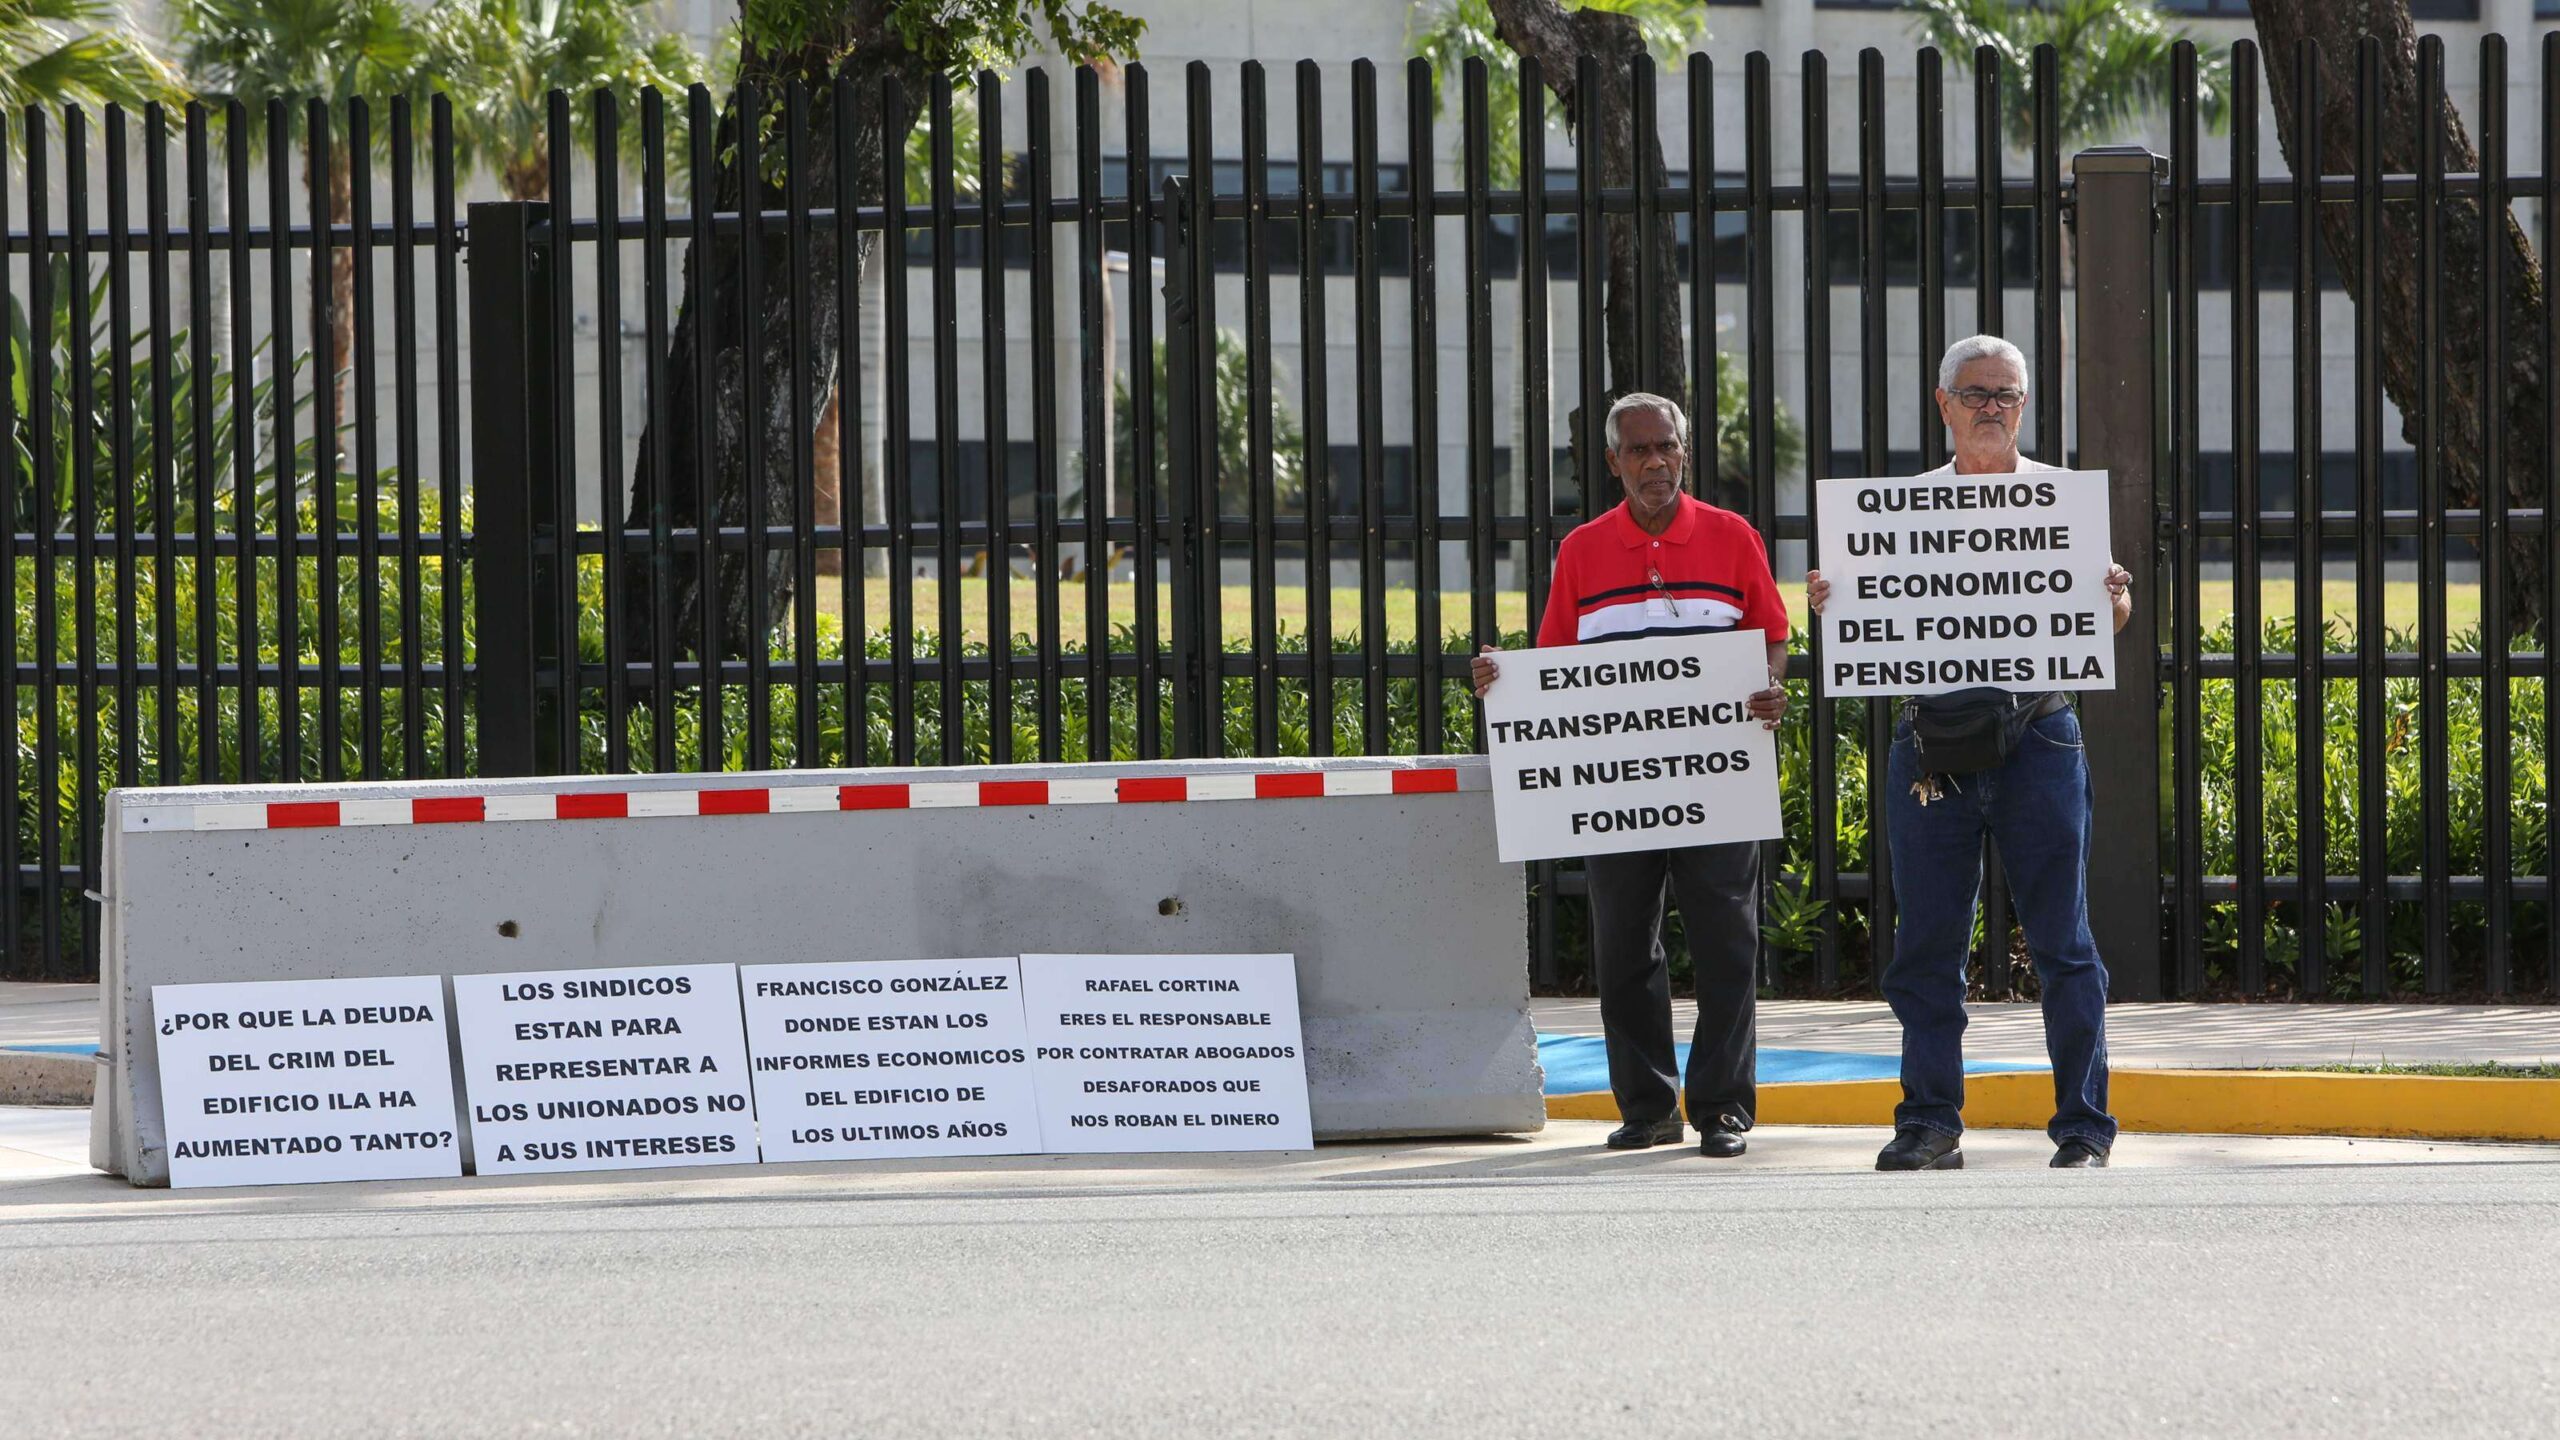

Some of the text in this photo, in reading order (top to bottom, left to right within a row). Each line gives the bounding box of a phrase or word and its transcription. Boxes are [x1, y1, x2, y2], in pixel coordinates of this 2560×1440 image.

[1857, 482, 2056, 515] QUEREMOS
[1847, 525, 2070, 557] UN INFORME
[1857, 569, 2073, 600] ECONOMICO
[1838, 612, 2096, 644] DEL FONDO DE
[1539, 656, 1701, 691] EXIGIMOS
[1834, 655, 2105, 687] PENSIONES ILA
[1490, 701, 1756, 745] TRANSPARENCI
[1518, 749, 1750, 791] EN NUESTROS
[1571, 802, 1706, 835] FONDOS
[502, 976, 692, 1002] LOS SINDICOS
[756, 970, 1009, 997] FRANCISCO GONZÁLEZ
[1085, 979, 1240, 993] RAFAEL CORTINA
[160, 1005, 434, 1036] ¿POR QUE LA DEUDA
[514, 1016, 682, 1041] ESTAN PARA
[784, 1013, 989, 1034] DONDE ESTAN LOS
[1059, 1013, 1272, 1026] ERES EL RESPONSABLE
[208, 1049, 395, 1072] DEL CRIM DEL
[756, 1048, 1026, 1072] INFORMES ECONOMICOS
[1036, 1046, 1295, 1060] POR CONTRATAR ABOGADOS
[495, 1055, 718, 1082] REPRESENTAR A
[805, 1086, 986, 1107] DEL EDIFICIO DE
[1083, 1079, 1261, 1093] DESAFORADOS QUE
[203, 1090, 417, 1115] EDIFICIO ILA HA
[476, 1094, 746, 1123] LOS UNIONADOS NO
[791, 1120, 1008, 1144] LOS ULTIMOS AÑOS
[1070, 1113, 1280, 1128] NOS ROBAN EL DINERO
[174, 1130, 453, 1159] AUMENTADO TANTO?
[496, 1134, 736, 1162] A SUS INTERESES
